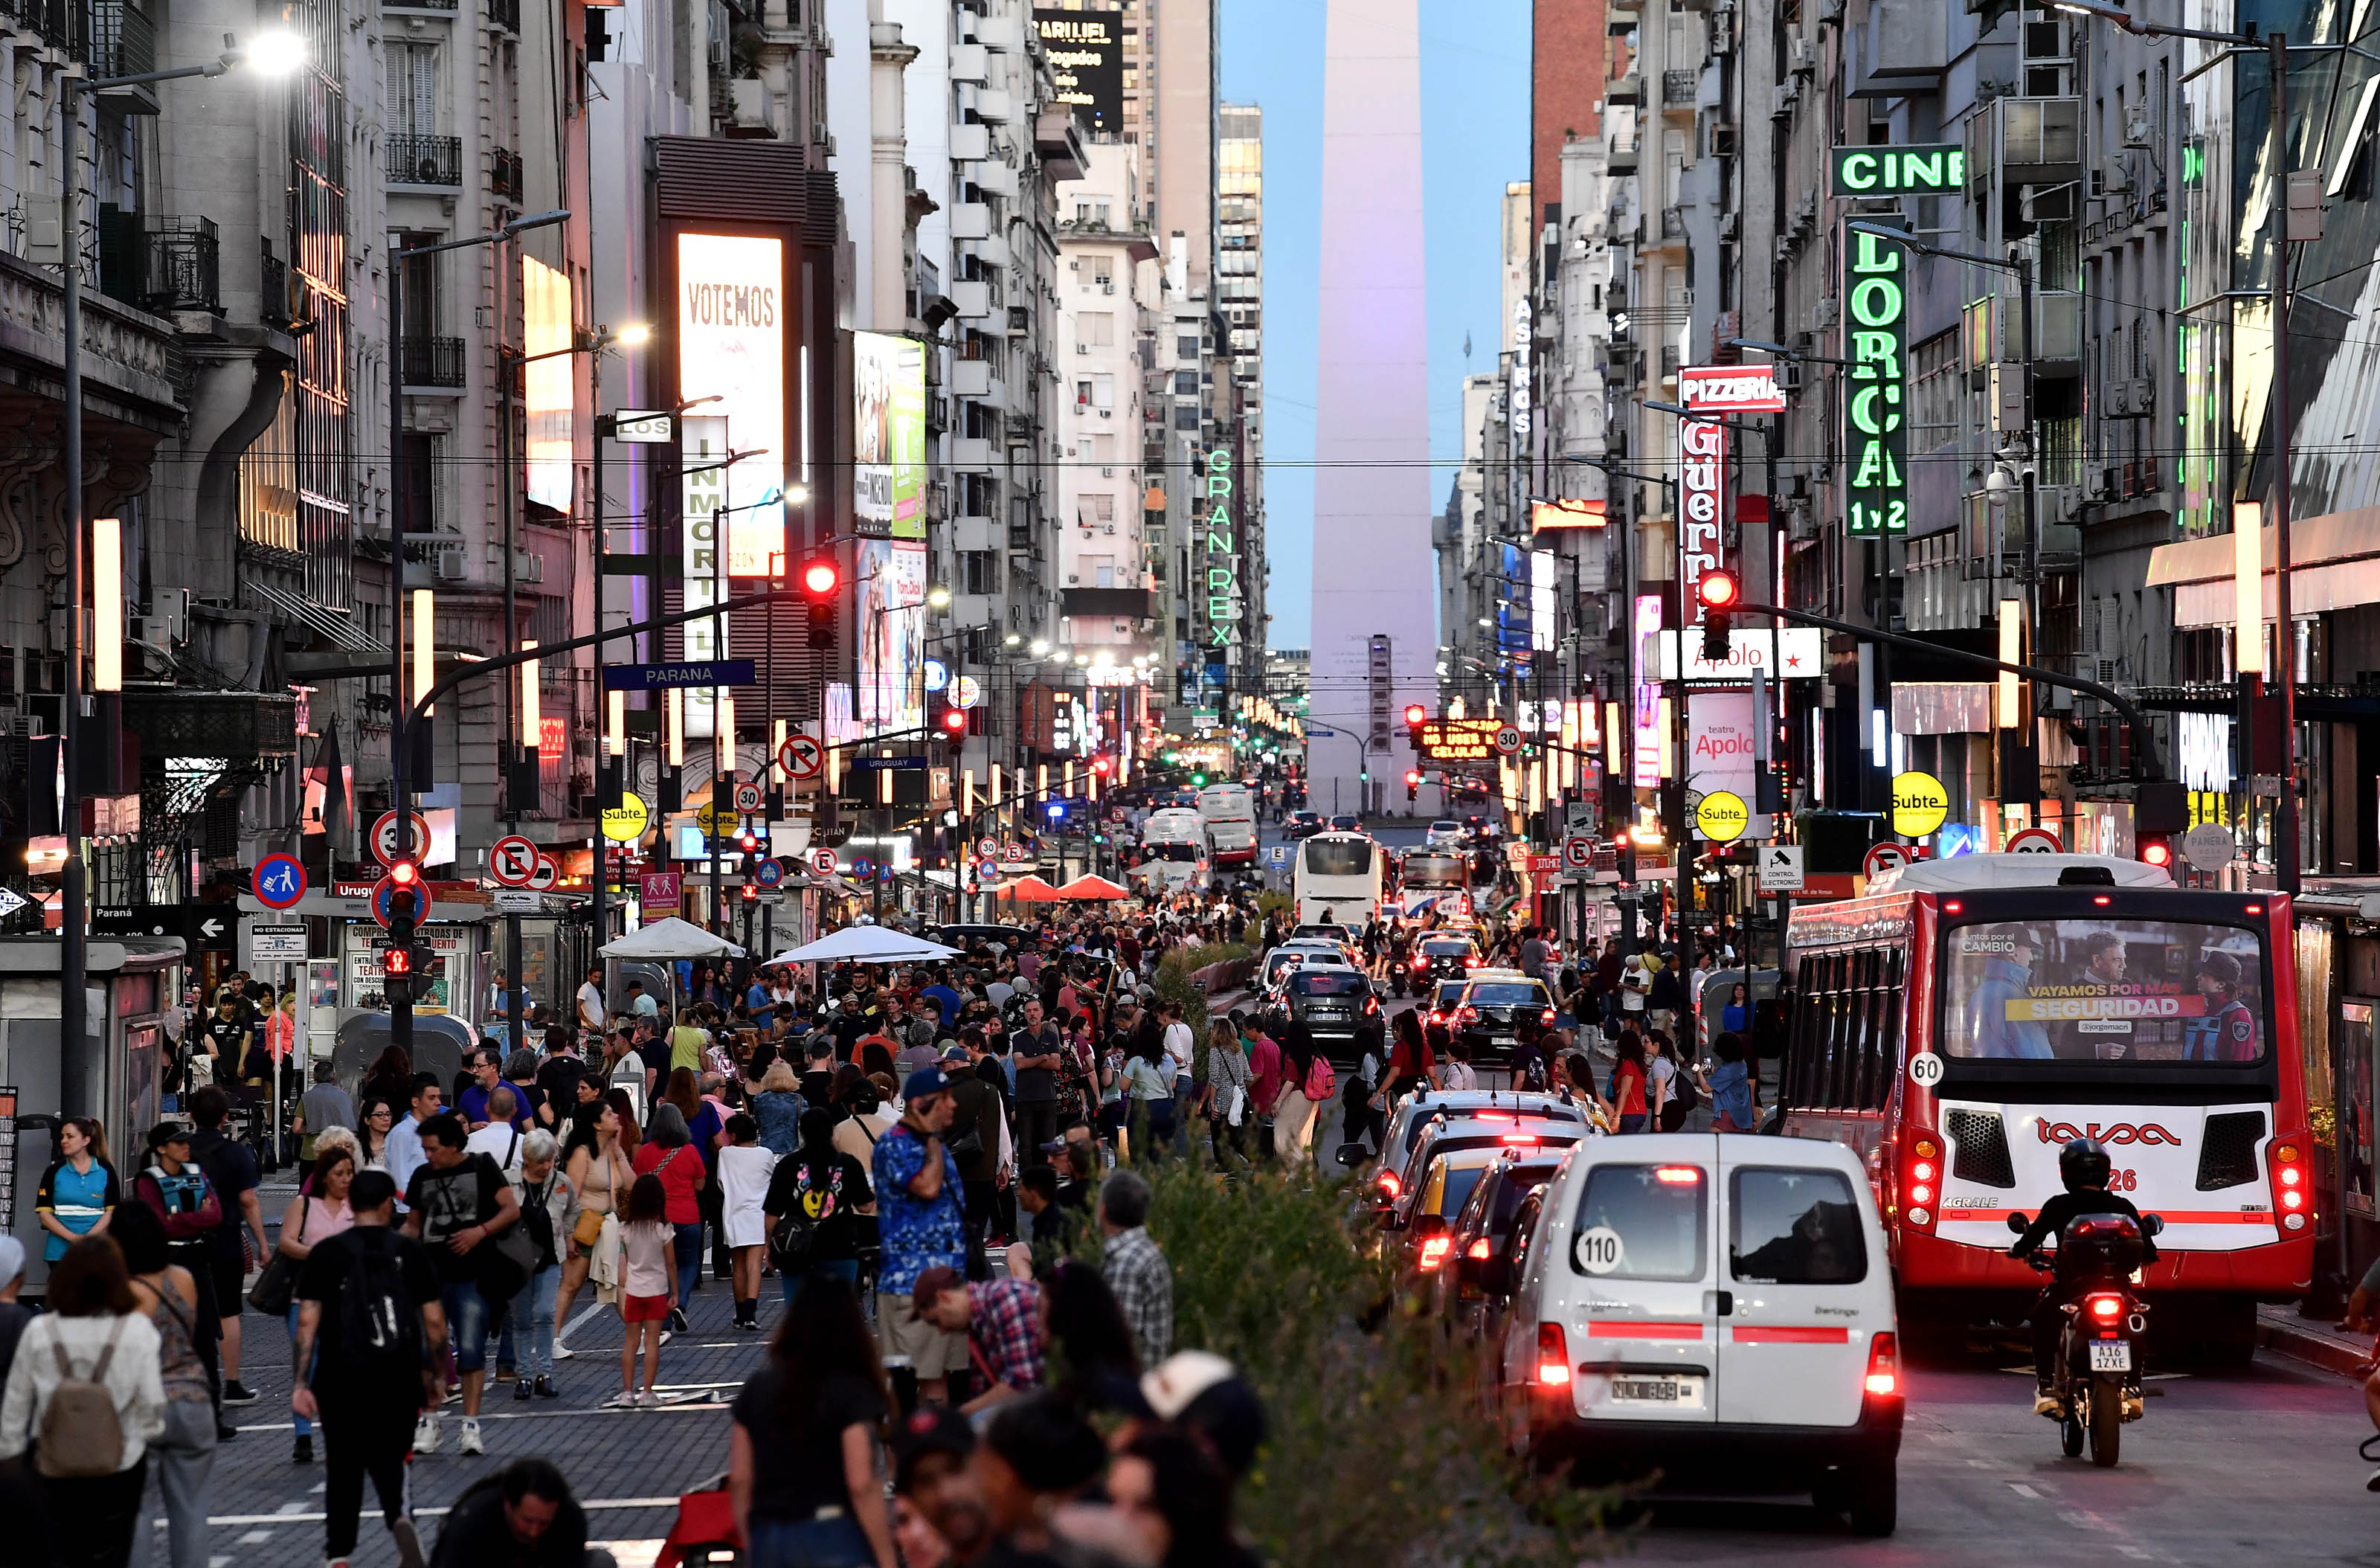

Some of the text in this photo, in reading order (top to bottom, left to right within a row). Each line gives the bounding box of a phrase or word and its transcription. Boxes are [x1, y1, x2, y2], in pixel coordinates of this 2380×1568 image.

[1046, 48, 1102, 68] bogados
[1842, 152, 1964, 188] CINE
[689, 282, 774, 327] VOTEMOS
[1850, 229, 1903, 487] LORCA
[1514, 299, 1531, 433] ASTROS
[1683, 376, 1784, 402] PIZZERIA
[619, 420, 669, 434] LOS
[1682, 417, 1718, 622] Güerr
[689, 439, 720, 705] INMORTLS
[646, 668, 713, 684] PARANA
[1424, 734, 1441, 745] NO
[1447, 733, 1480, 745] USES
[1500, 733, 1517, 745] 30
[1432, 746, 1488, 757] CELULAR
[1696, 733, 1755, 760] Apolo
[869, 759, 908, 768] URUGUAY
[741, 791, 756, 805] 30
[1893, 794, 1938, 809] Subte
[604, 809, 641, 820] Subte
[1704, 809, 1740, 820] Subte
[2191, 836, 2228, 846] PANERA
[982, 843, 994, 852] 30
[1912, 846, 1919, 856] B
[605, 867, 640, 875] Uruuay
[340, 885, 373, 897] Urug
[96, 907, 132, 918] Paraná
[416, 928, 451, 939] NTRADAS
[453, 929, 463, 939] DE
[1962, 933, 2015, 943] Juntos por el
[432, 939, 457, 949] UENTO
[1962, 942, 2016, 953] CAMBIO
[358, 965, 385, 976] TEATR
[2029, 981, 2182, 997] VAYAMOS POR MÁS
[2031, 999, 2179, 1019] SEGURIDAD
[2082, 1023, 2129, 1032] @jorgemacri
[1914, 1060, 1938, 1079] 60
[2109, 1168, 2137, 1192] 26
[1942, 1197, 1999, 1208] AGRALE
[1584, 1236, 1617, 1265] 110
[2099, 1346, 2121, 1357] A16
[2096, 1357, 2126, 1369] 1ZXE
